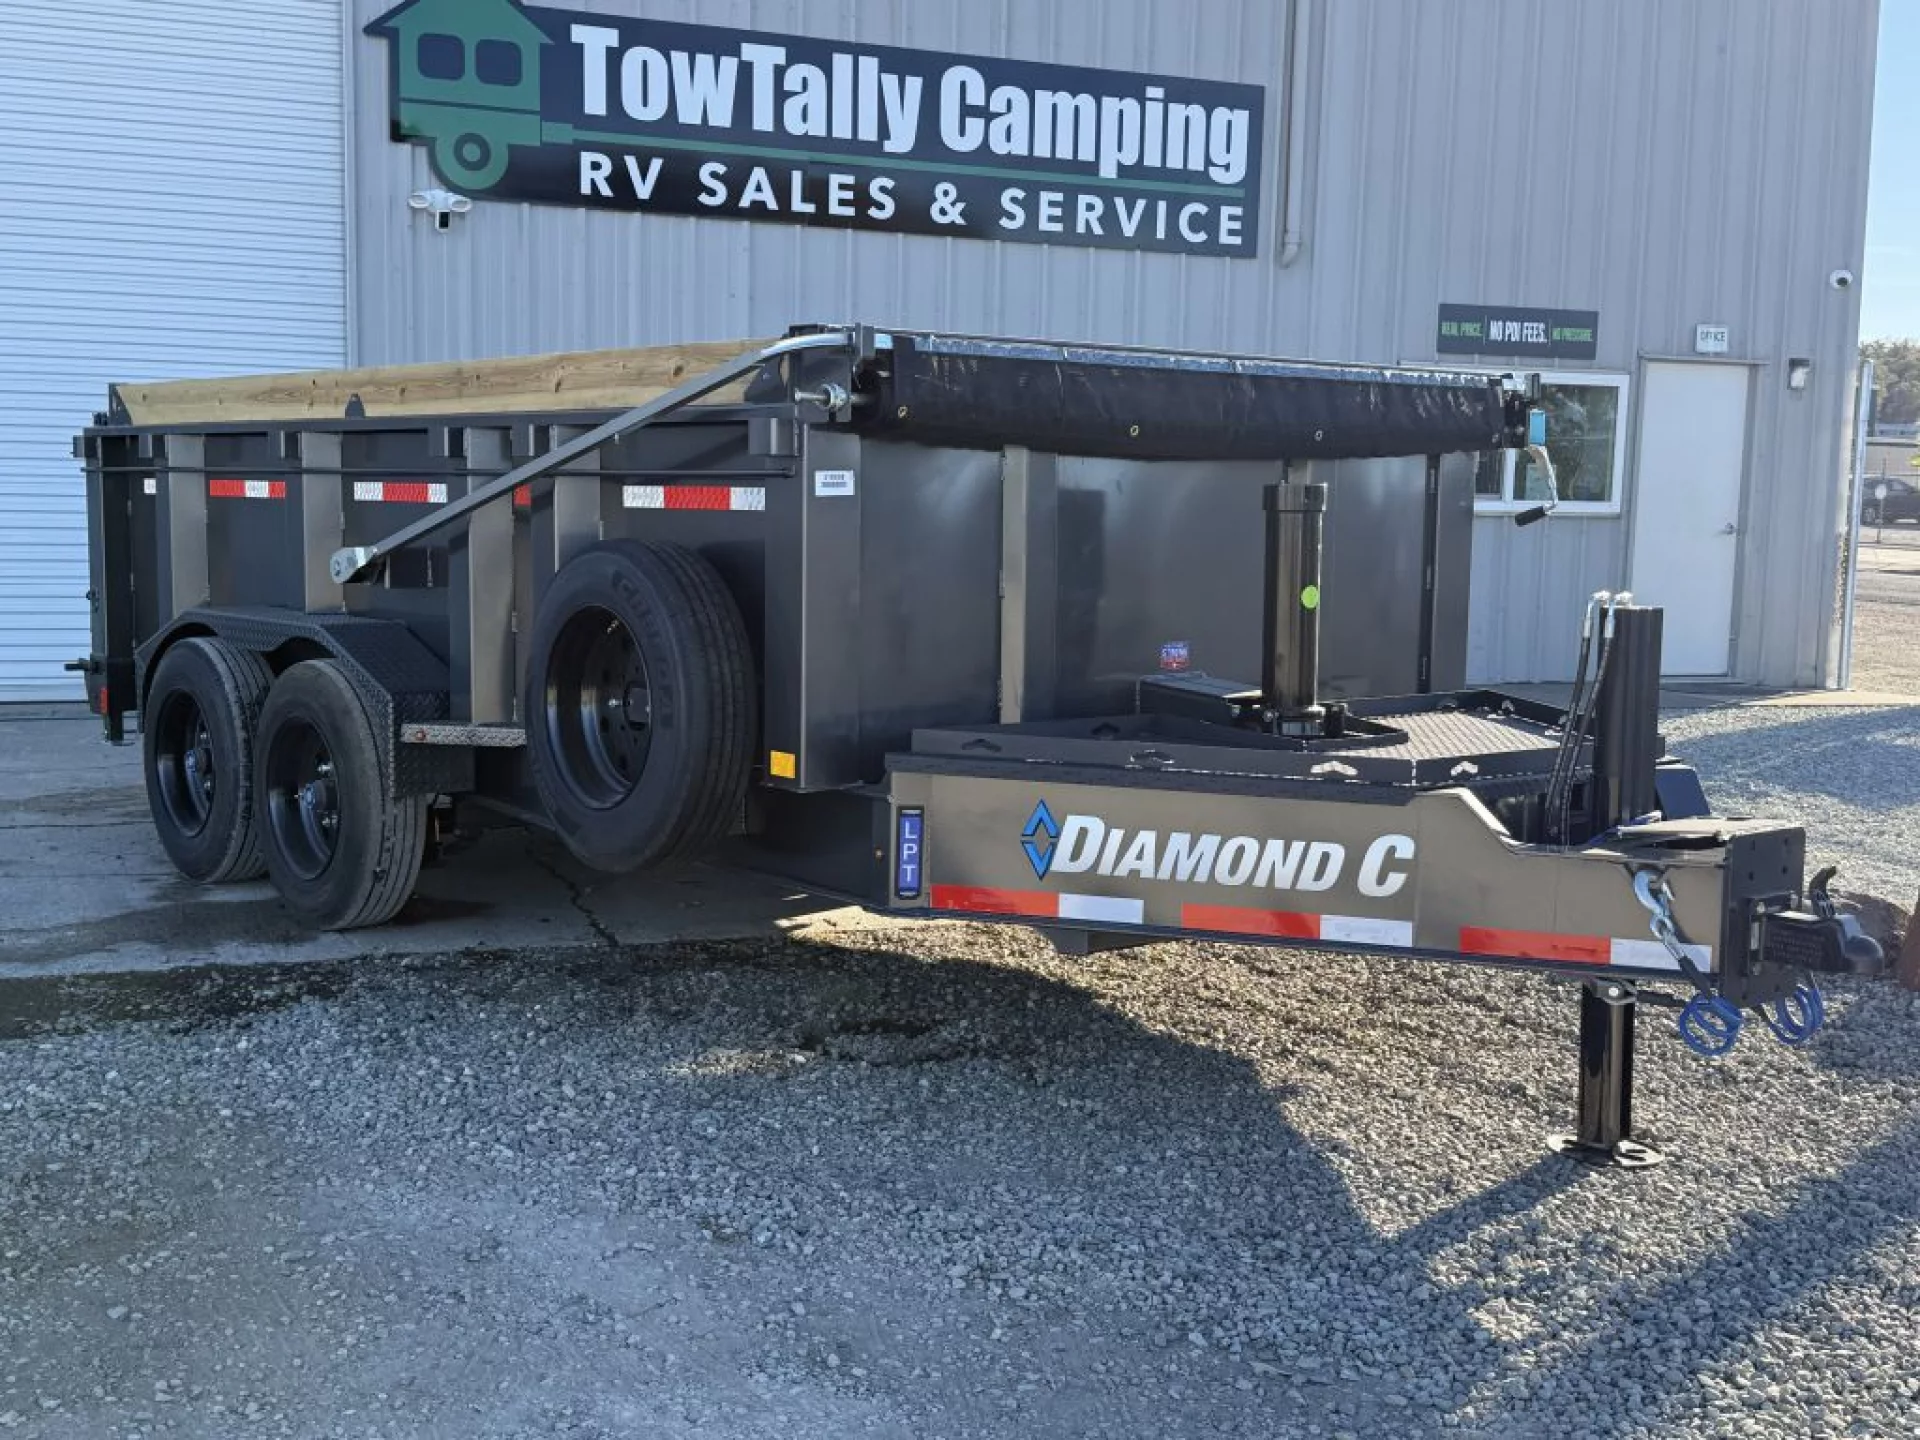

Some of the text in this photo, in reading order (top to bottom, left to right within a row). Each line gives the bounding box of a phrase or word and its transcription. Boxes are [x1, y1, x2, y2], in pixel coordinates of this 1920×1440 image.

[570, 23, 1250, 184] TowTally Camping
[579, 151, 1244, 246] RV SALES & SERVICE
[1489, 319, 1502, 340] NO
[1522, 322, 1548, 343] FEES.
[1700, 331, 1726, 342] OFFICE
[1050, 814, 1415, 898] DIAMOND C
